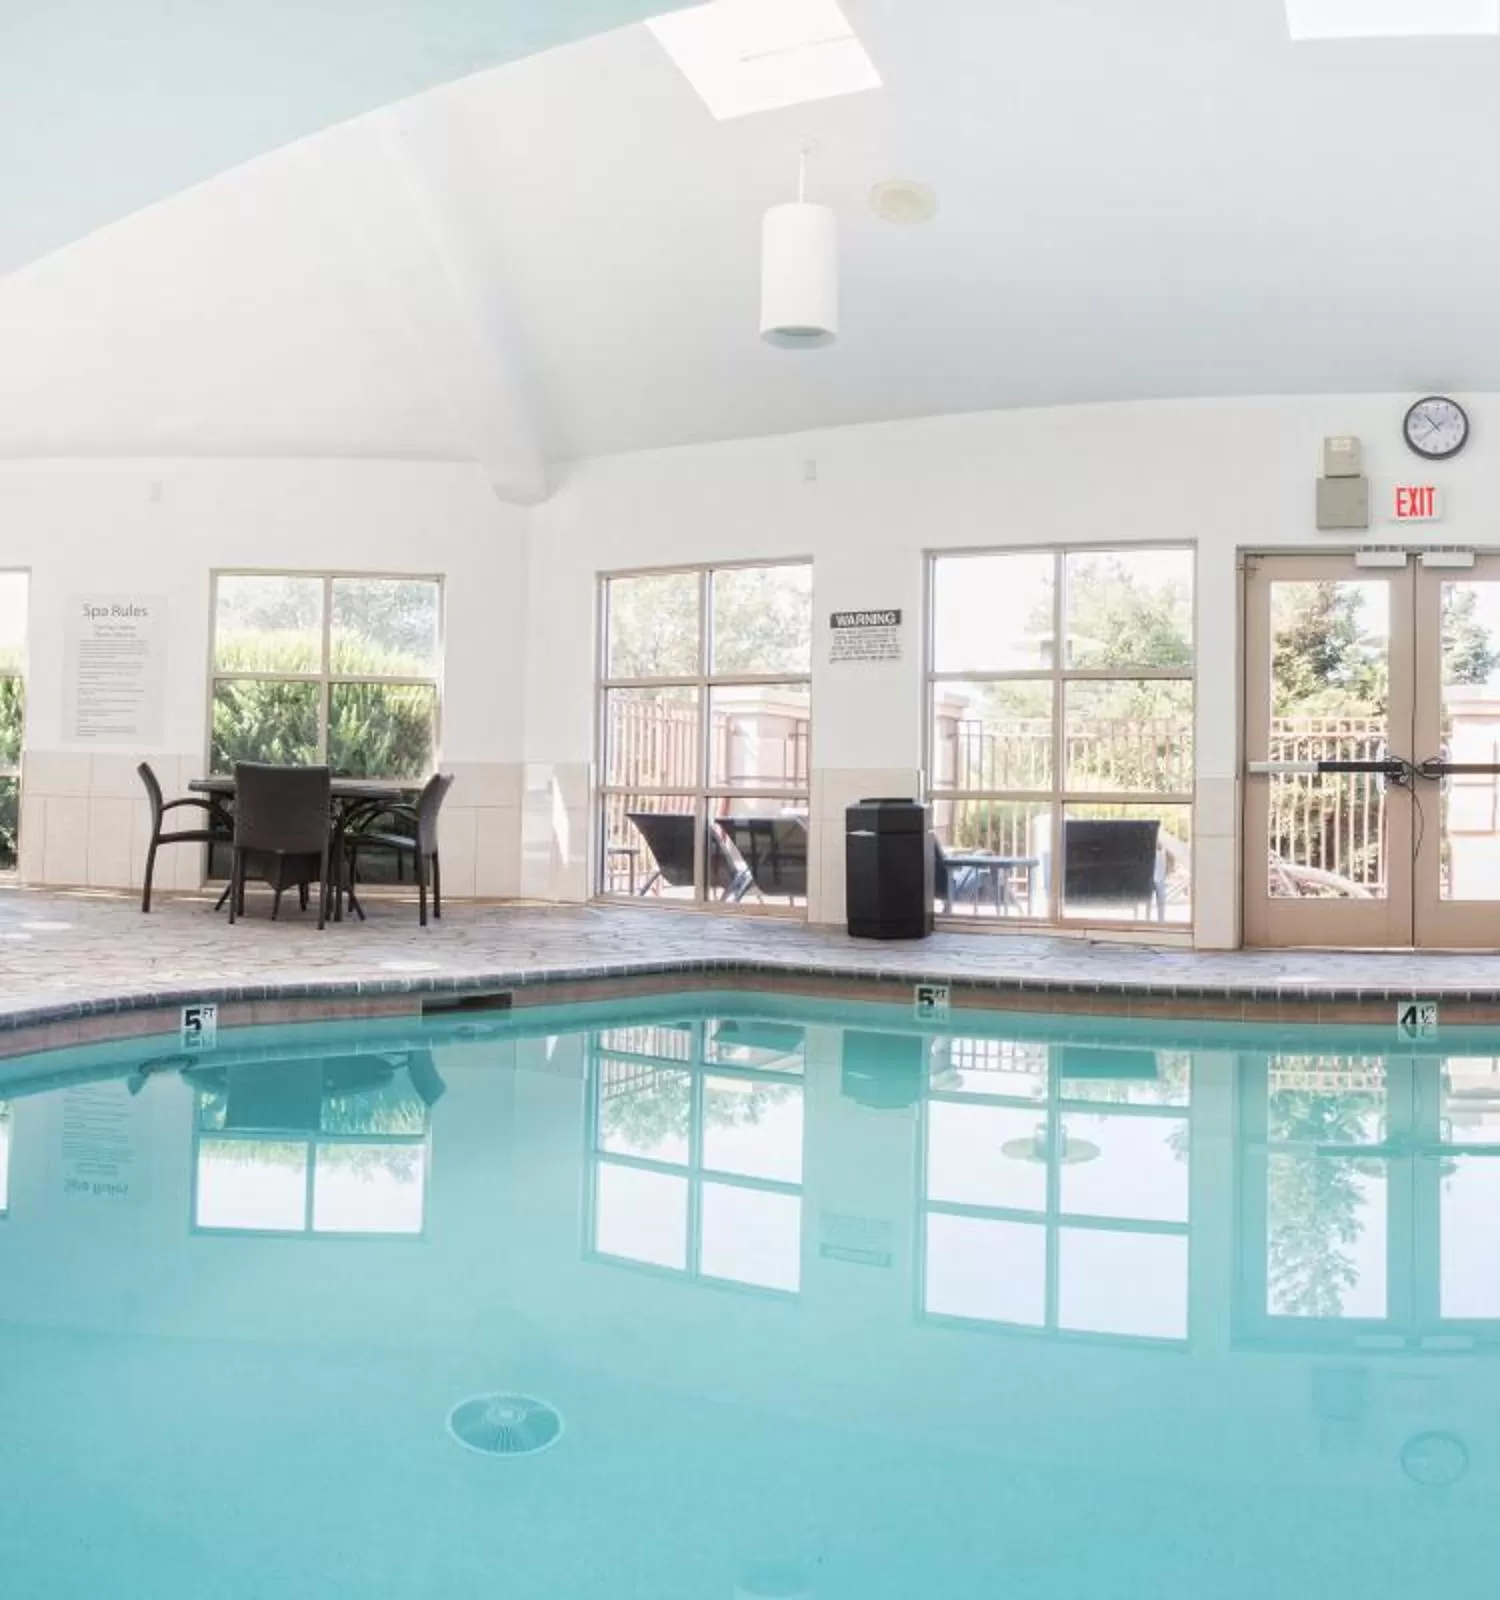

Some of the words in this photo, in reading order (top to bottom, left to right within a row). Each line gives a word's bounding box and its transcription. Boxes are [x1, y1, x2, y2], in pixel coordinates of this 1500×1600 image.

[1396, 487, 1435, 516] EXIT
[82, 603, 109, 620] Spa
[111, 603, 149, 617] Rules
[836, 612, 897, 625] WARNING
[918, 988, 934, 1006] 5
[185, 1009, 202, 1031] 5
